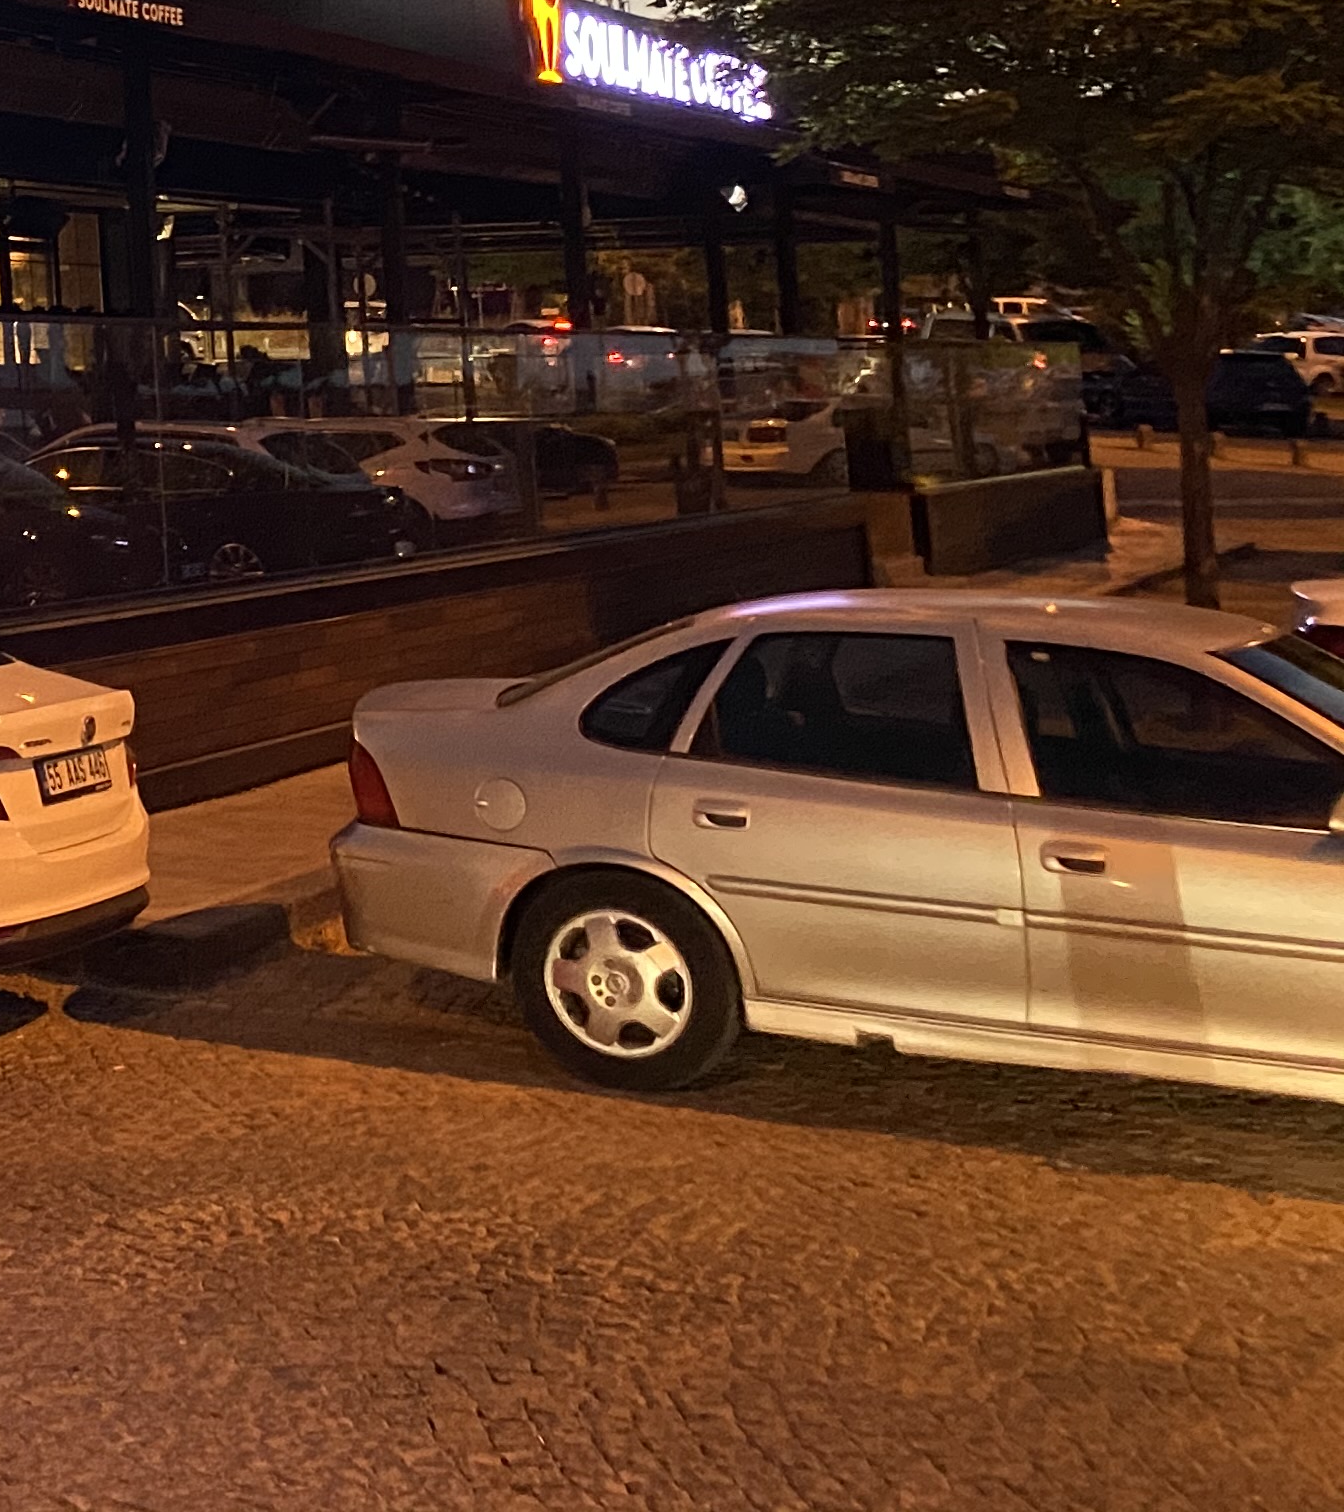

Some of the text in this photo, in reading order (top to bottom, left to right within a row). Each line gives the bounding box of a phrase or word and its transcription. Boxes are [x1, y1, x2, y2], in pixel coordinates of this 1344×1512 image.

[141, 1, 185, 27] COFFEE
[563, 10, 691, 102] SOULMATE
[47, 762, 63, 791] 55
